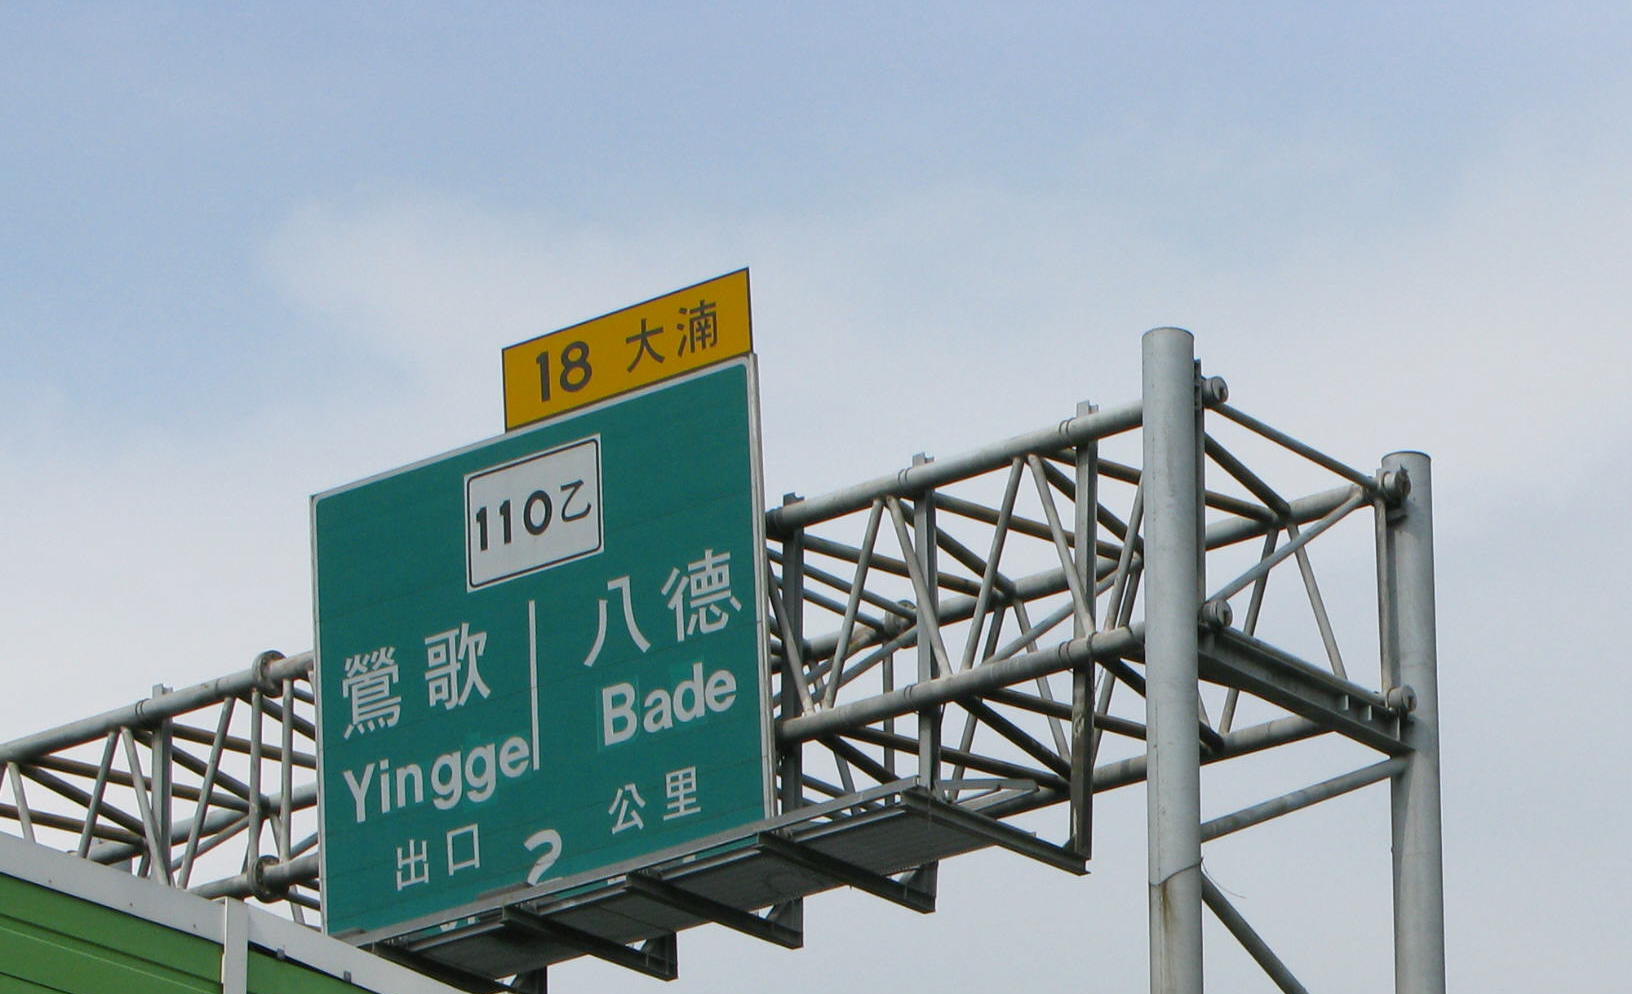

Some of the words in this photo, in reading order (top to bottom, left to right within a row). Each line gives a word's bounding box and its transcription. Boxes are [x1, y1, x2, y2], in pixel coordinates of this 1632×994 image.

[535, 340, 594, 403] 18
[624, 299, 719, 374] 大湳
[583, 548, 743, 668] 八德
[342, 621, 492, 741] 鶯歌
[600, 662, 738, 747] Bade
[342, 735, 531, 824] Yingge
[395, 822, 481, 892] 出口
[523, 828, 564, 886] 2
[607, 765, 702, 836] 公里
